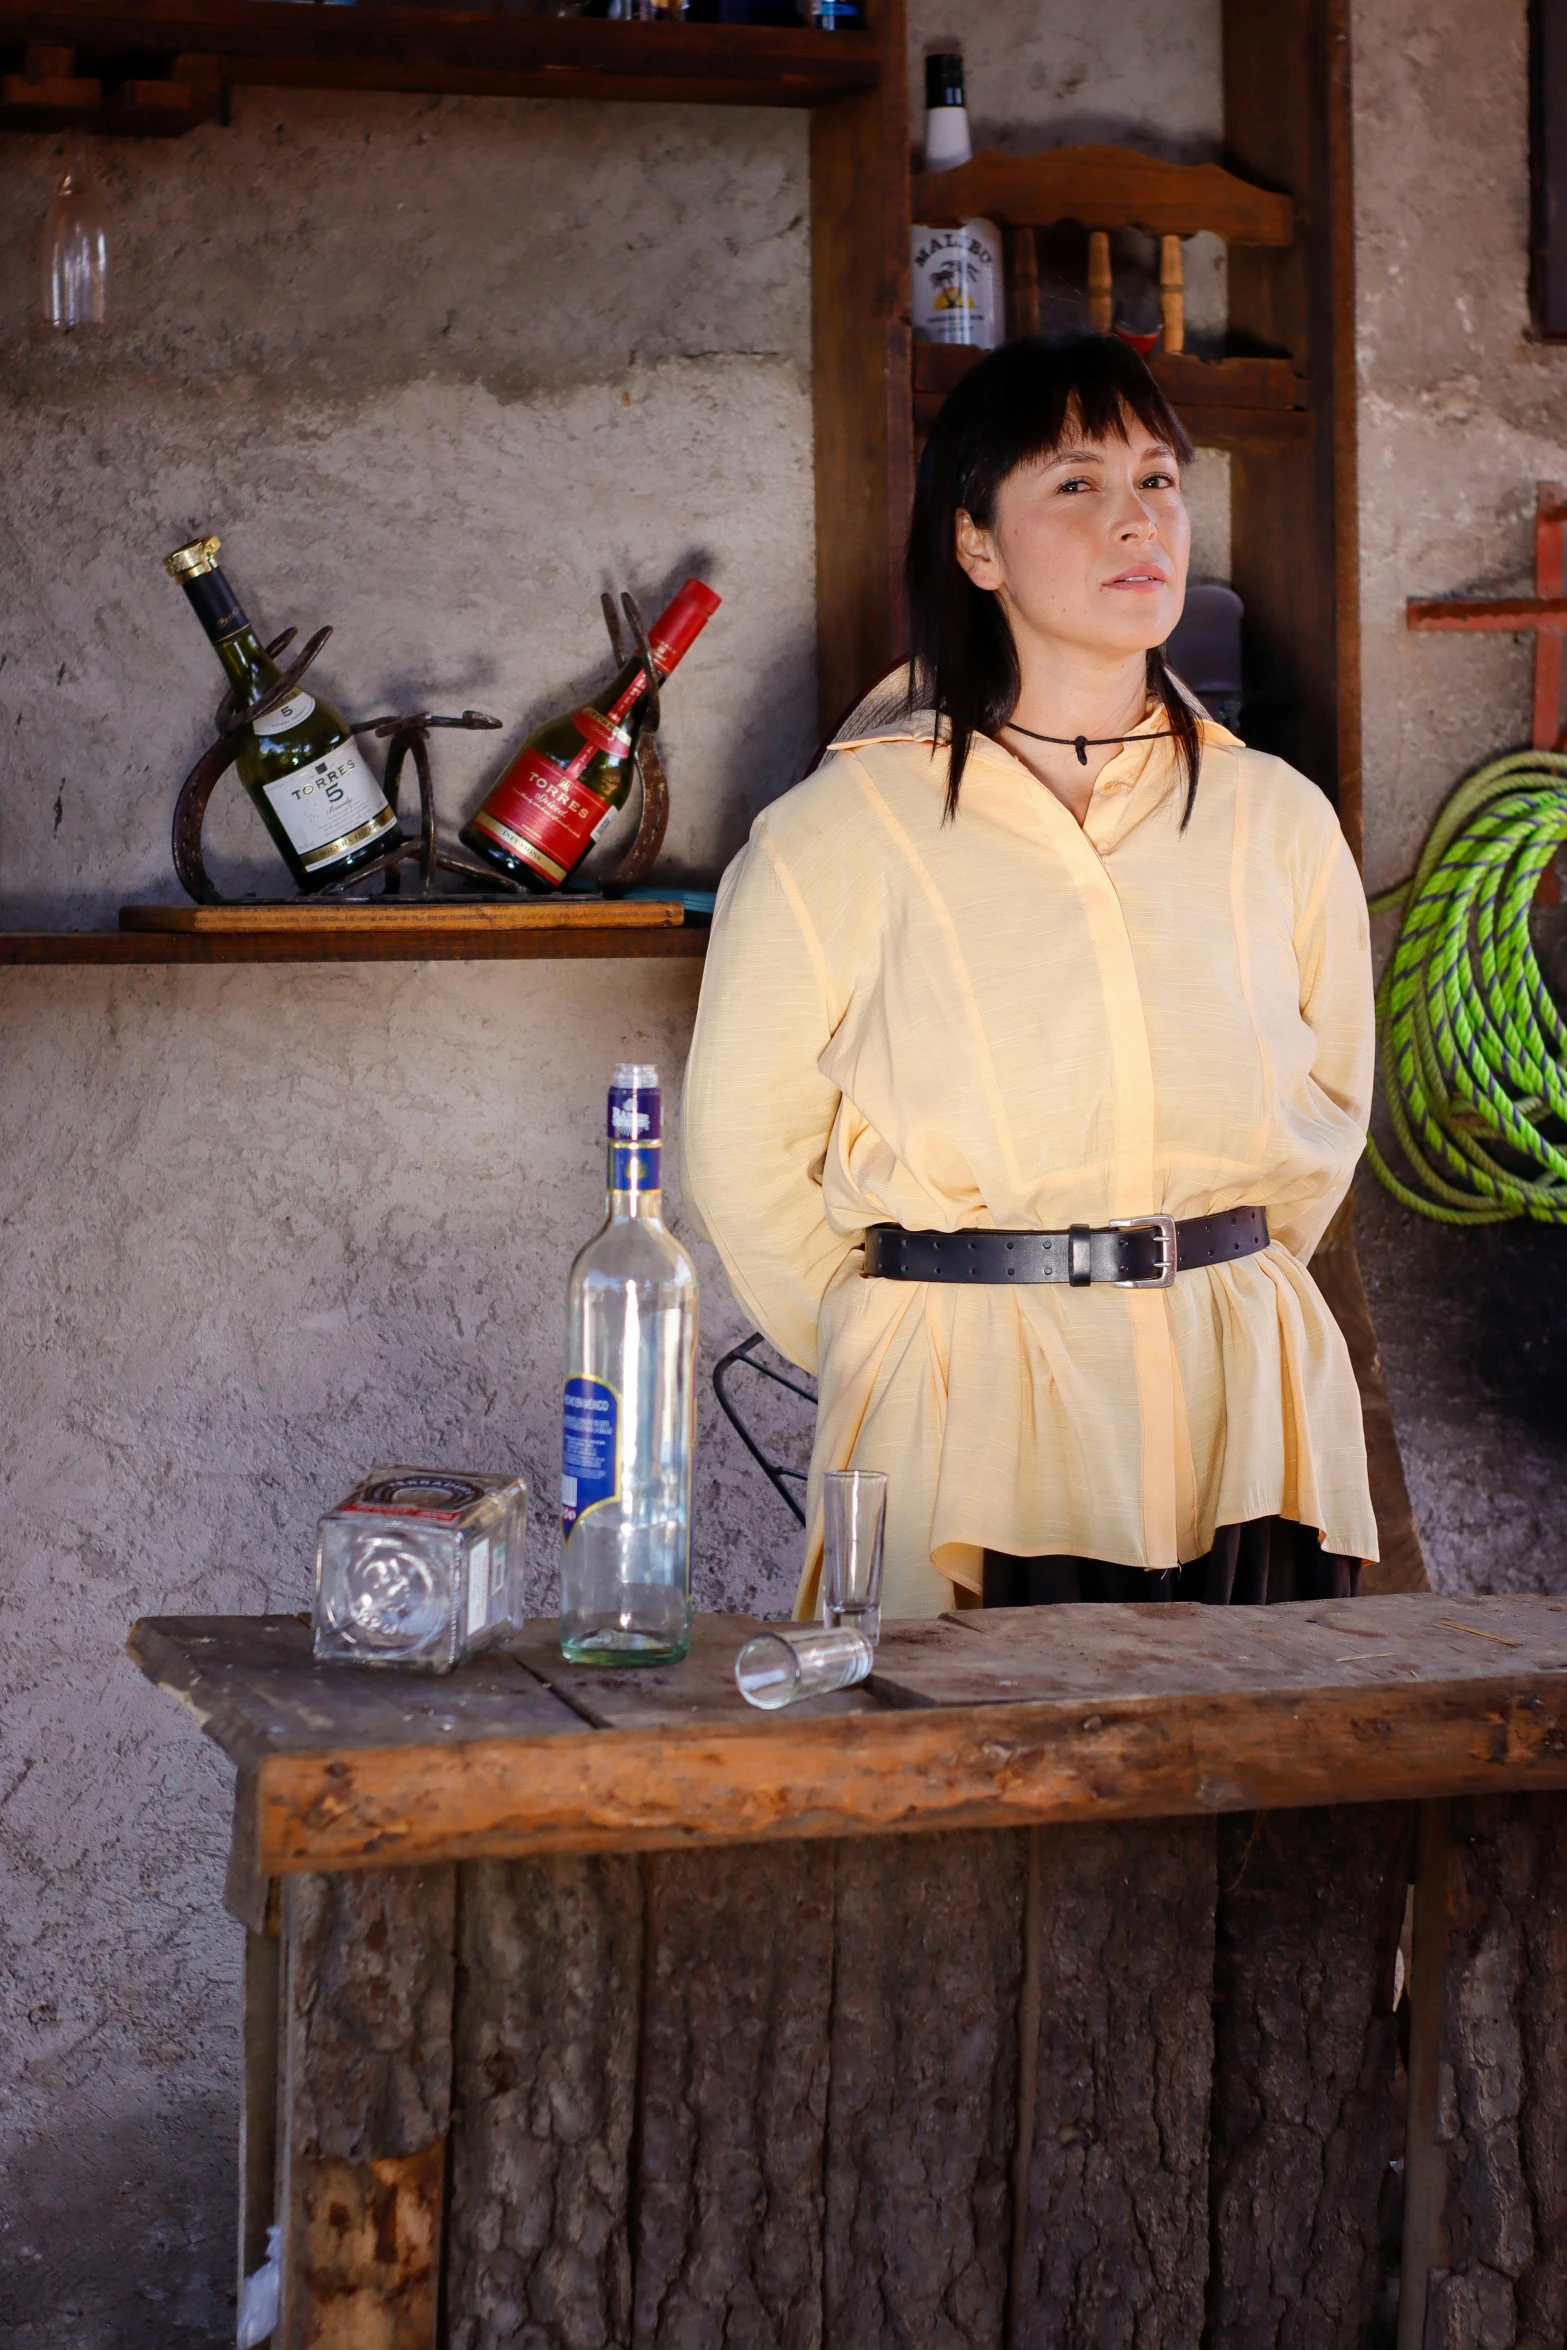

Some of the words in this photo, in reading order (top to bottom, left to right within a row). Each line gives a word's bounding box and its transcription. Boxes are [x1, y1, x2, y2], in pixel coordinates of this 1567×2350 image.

[281, 706, 294, 718] 5
[291, 758, 356, 801] TORRES
[325, 782, 345, 803] 5
[528, 771, 590, 819] TORRES
[535, 792, 568, 819] Spiced
[501, 829, 542, 862] INFUSIONS
